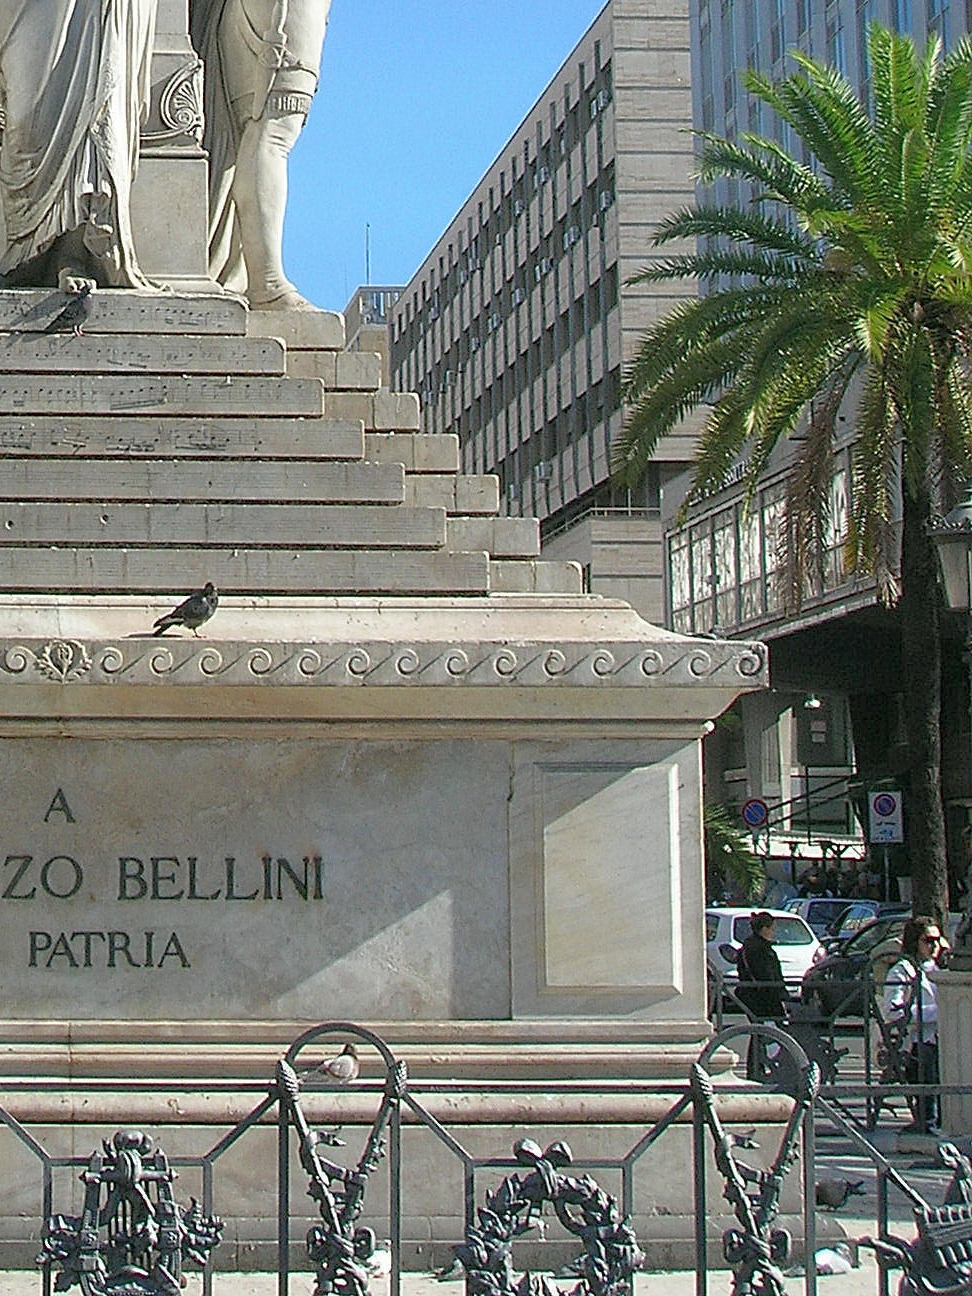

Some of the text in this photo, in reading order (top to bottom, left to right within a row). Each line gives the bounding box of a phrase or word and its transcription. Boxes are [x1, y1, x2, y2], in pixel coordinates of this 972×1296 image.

[43, 787, 76, 823] A
[117, 855, 325, 902] BELLINI
[28, 931, 191, 968] PATRIA
